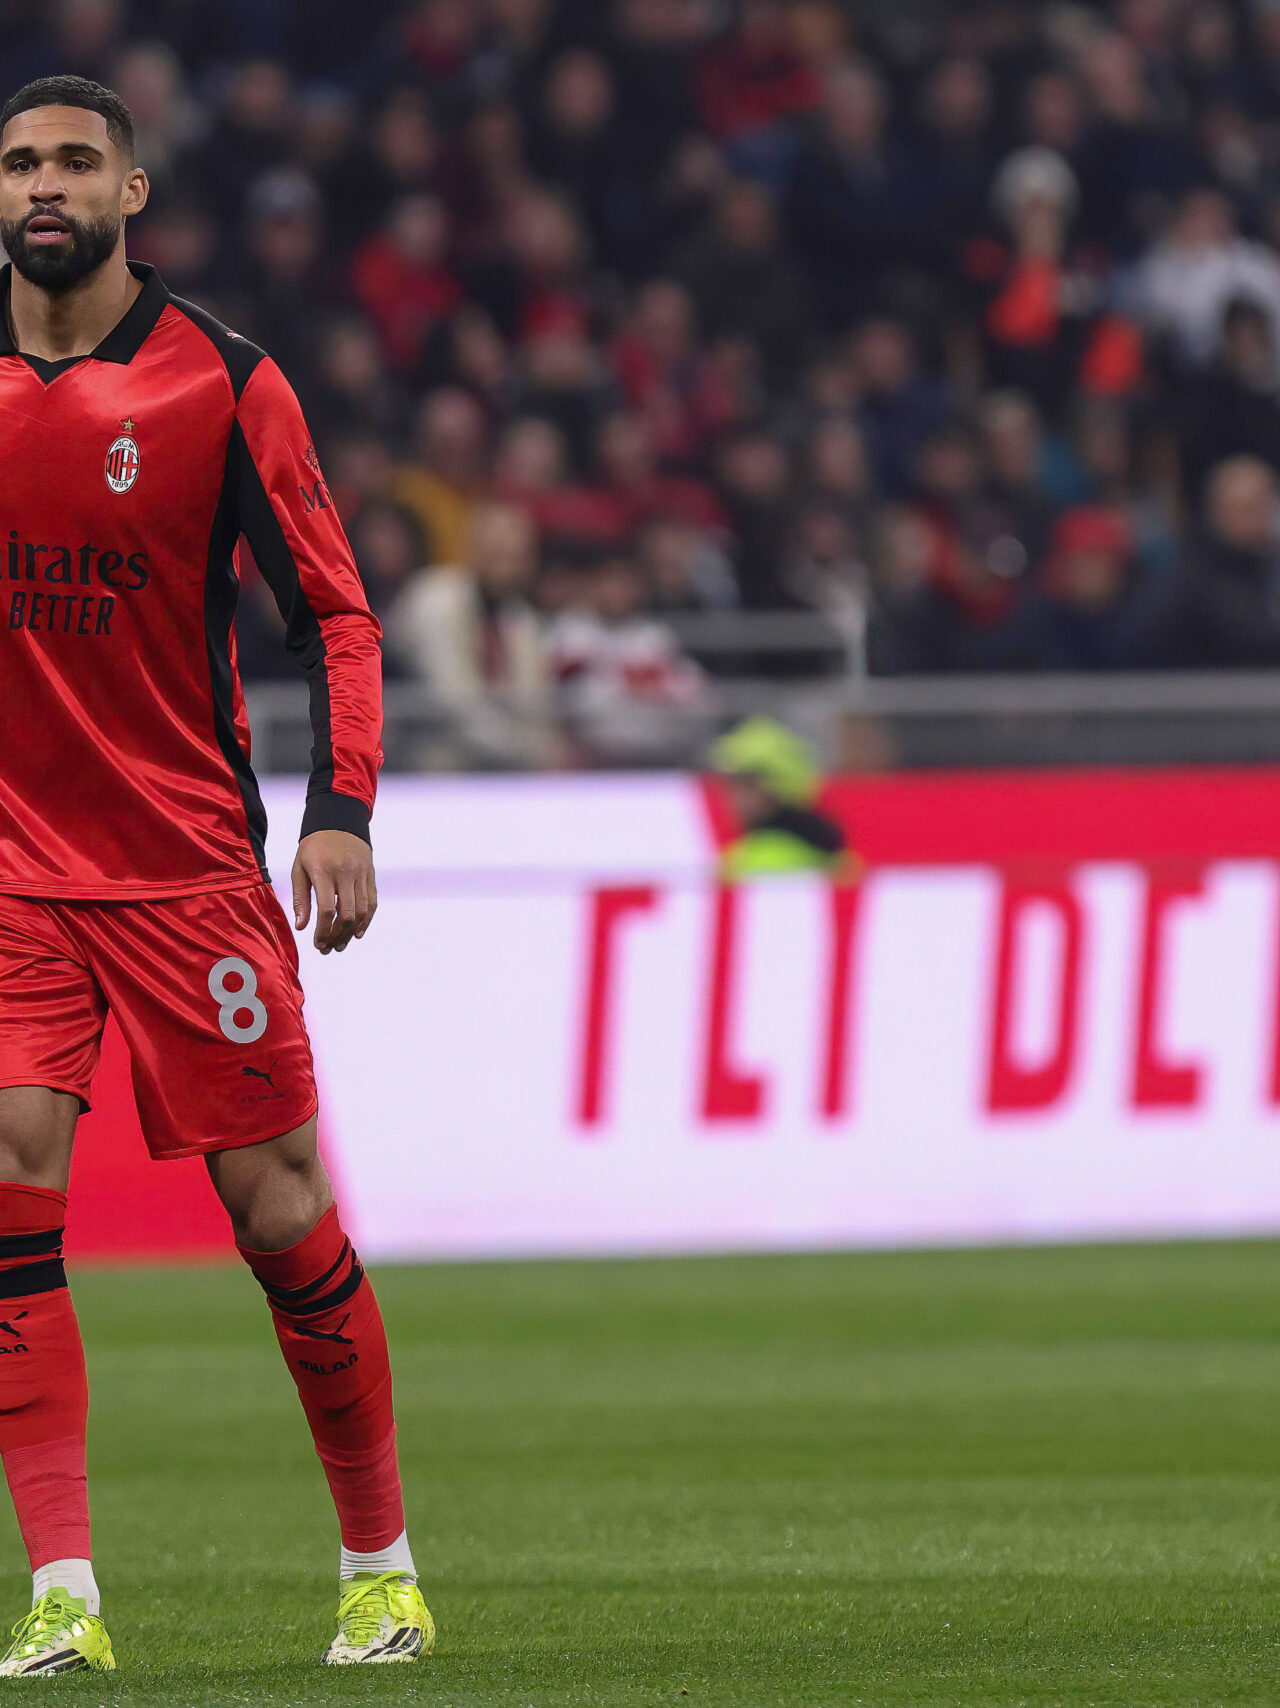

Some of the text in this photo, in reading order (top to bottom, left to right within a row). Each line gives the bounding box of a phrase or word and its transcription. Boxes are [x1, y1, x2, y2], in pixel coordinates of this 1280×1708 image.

[115, 440, 136, 451] ACM
[111, 480, 129, 489] 1899
[8, 590, 116, 636] BETTER
[207, 956, 268, 1044] 8
